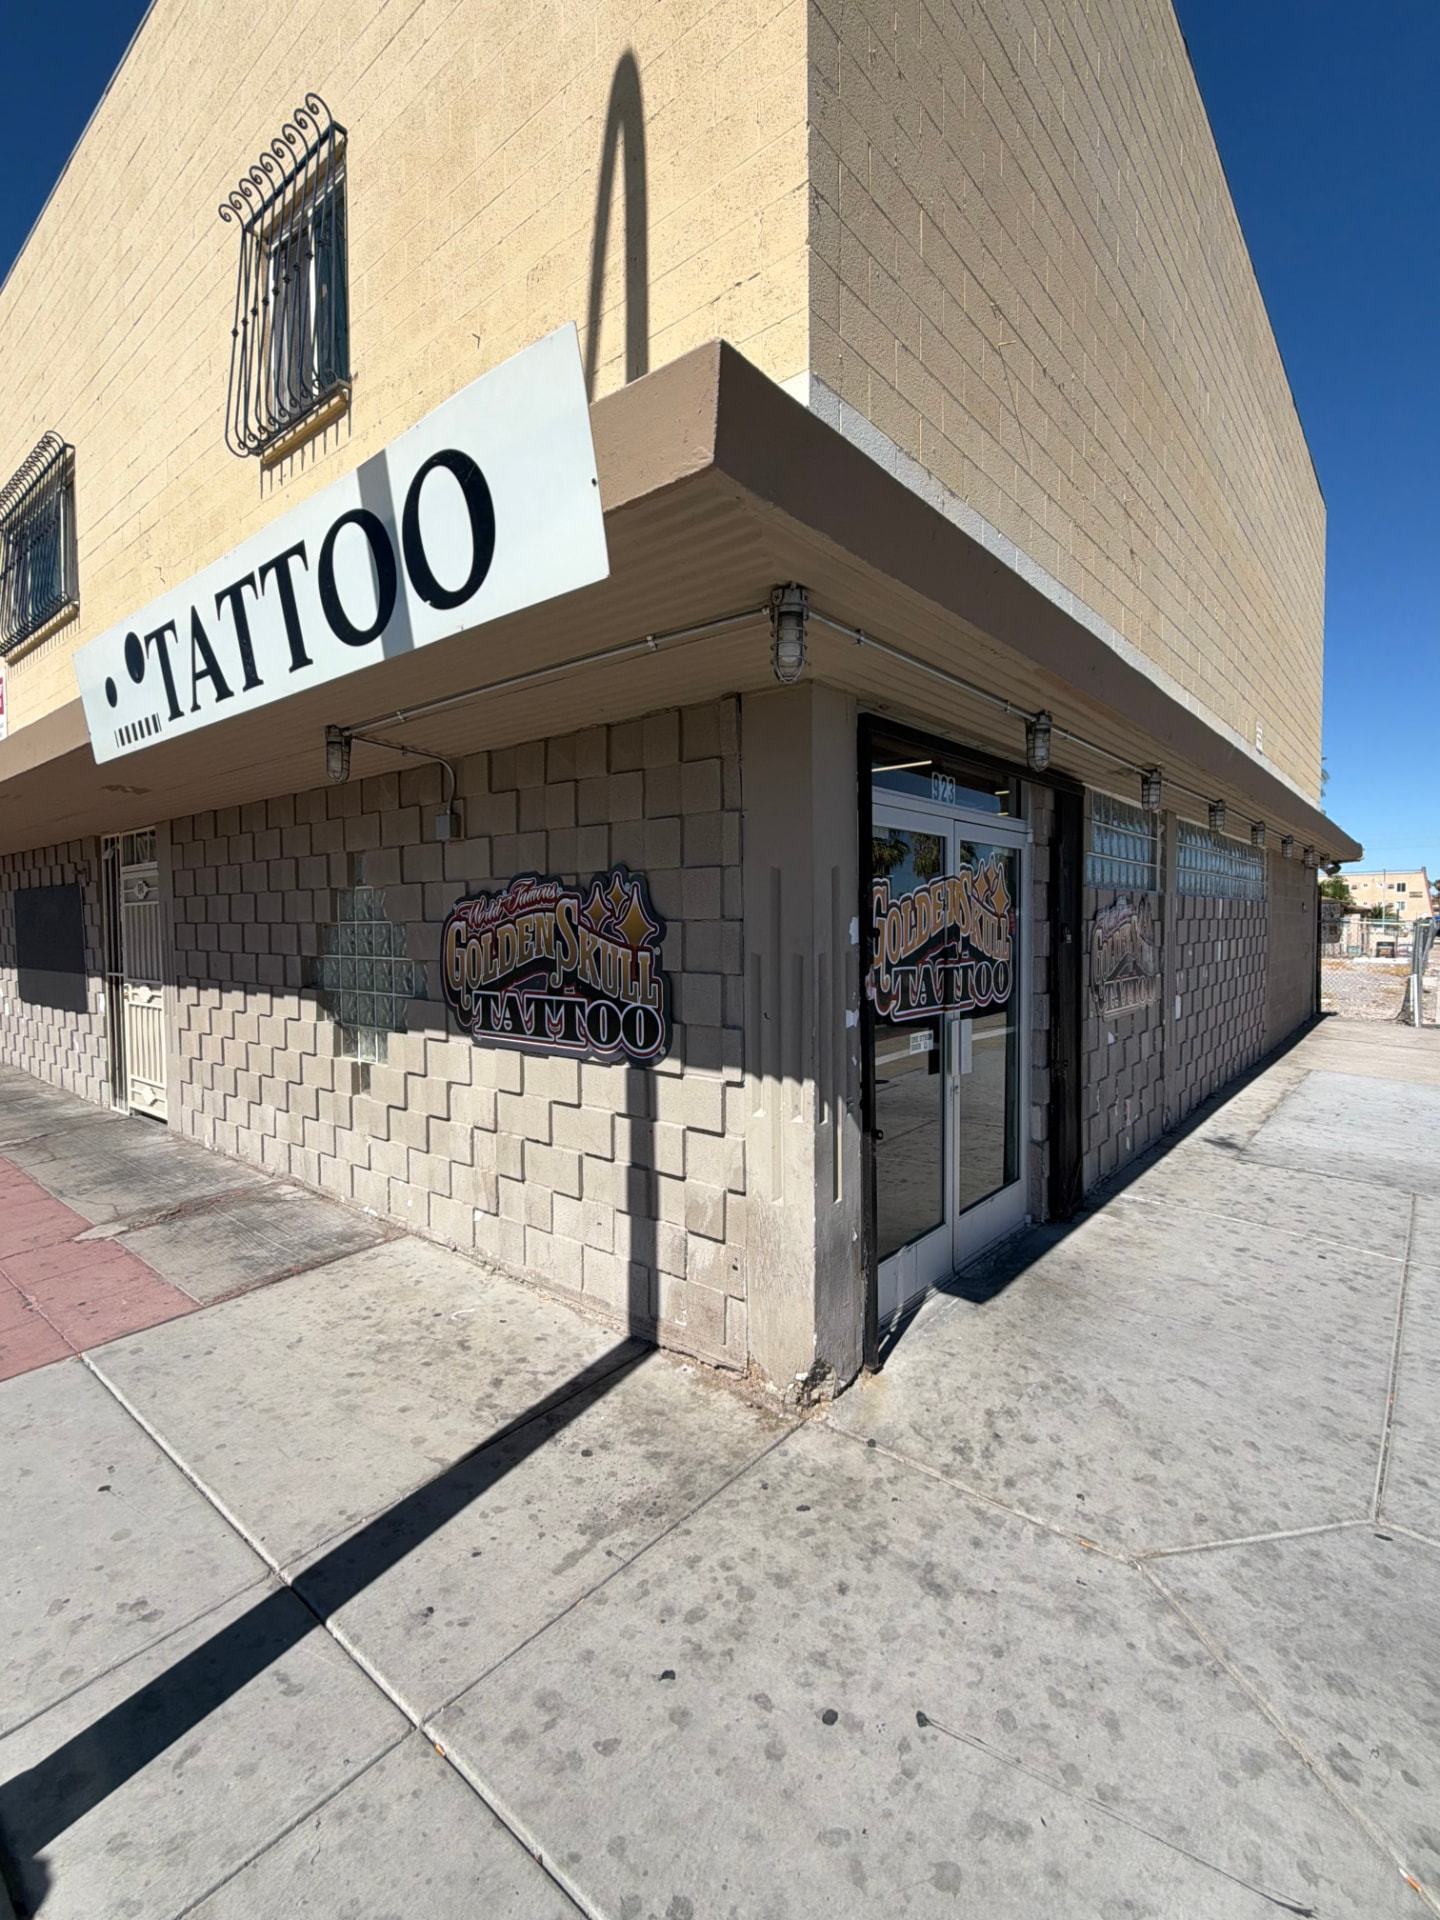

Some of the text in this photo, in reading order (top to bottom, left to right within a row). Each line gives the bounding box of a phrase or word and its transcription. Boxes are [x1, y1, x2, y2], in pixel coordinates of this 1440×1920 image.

[144, 448, 496, 723] TATTOO
[933, 773, 955, 804] 923
[504, 878, 560, 914] Famous
[446, 898, 659, 1010] GOLDEN SKULL
[891, 960, 1011, 1015] TATTOO
[473, 991, 663, 1053] TATTOO
